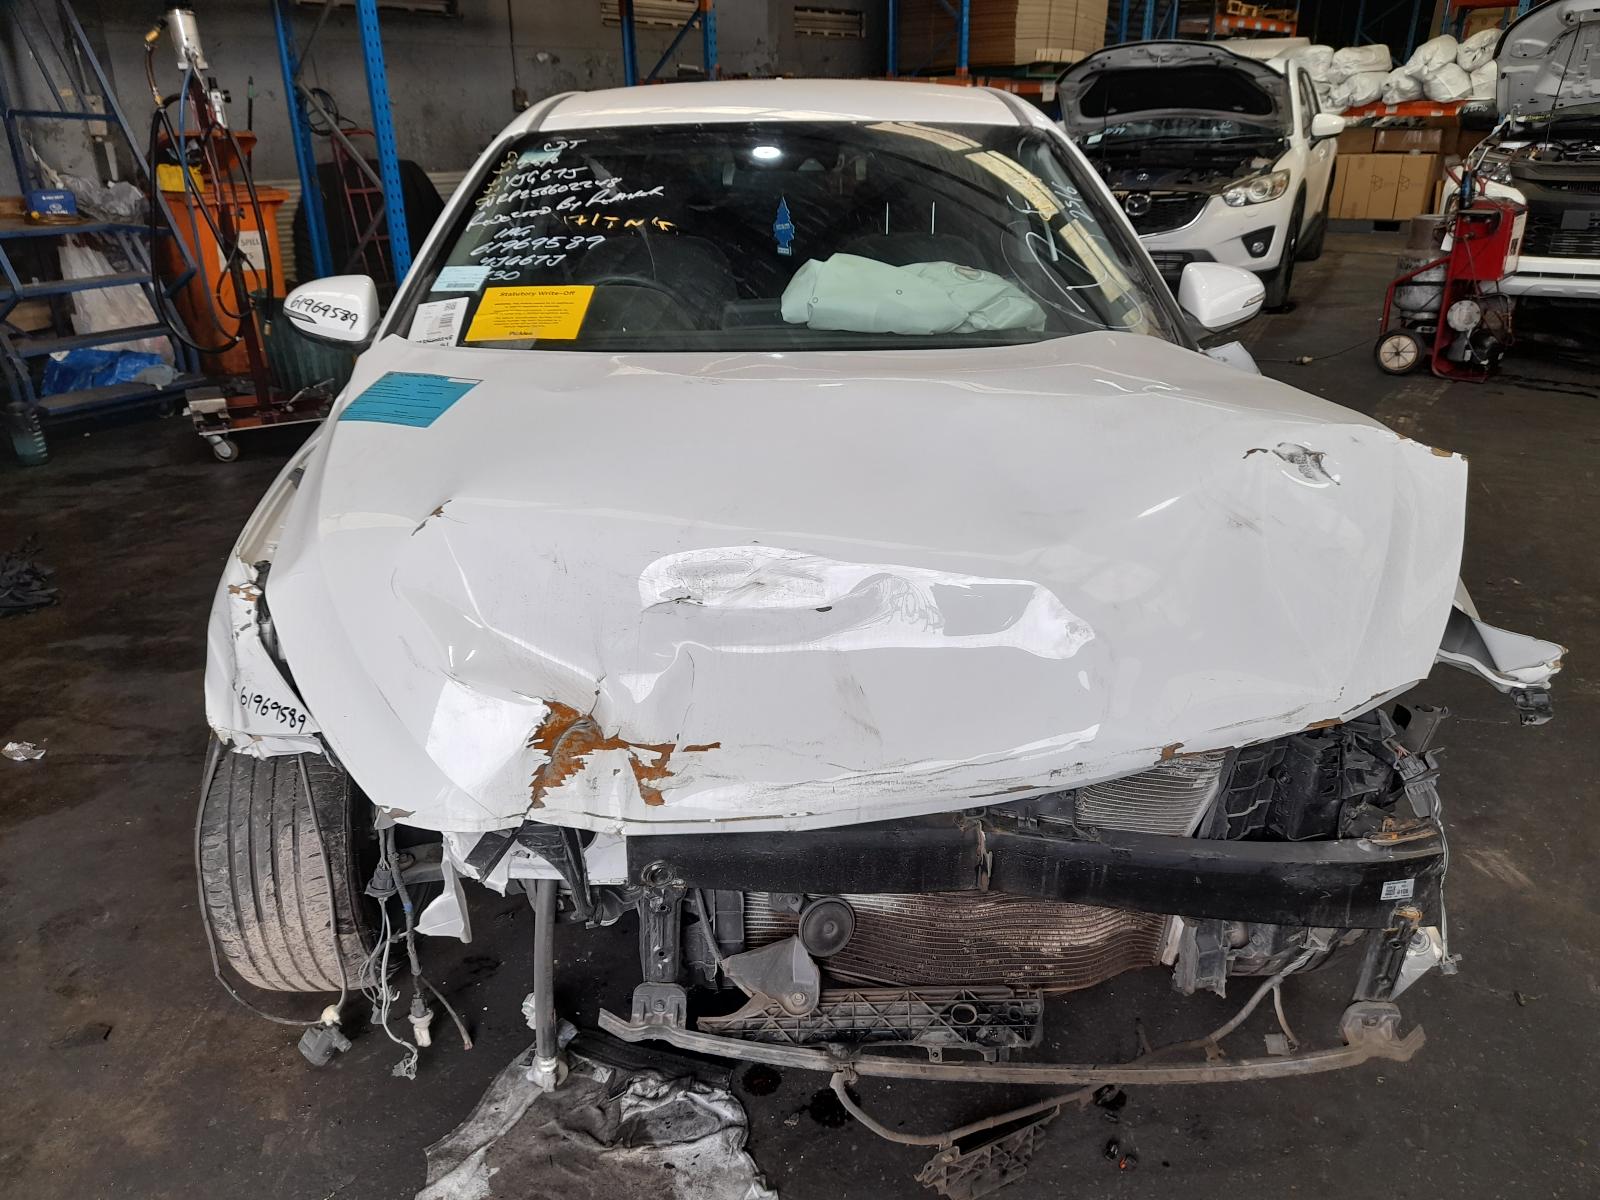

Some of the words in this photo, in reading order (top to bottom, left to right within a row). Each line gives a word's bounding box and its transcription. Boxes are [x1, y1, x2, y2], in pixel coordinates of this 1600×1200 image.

[470, 234, 607, 256] 61969589
[290, 294, 359, 331] 61969589
[240, 686, 306, 734] 61969589
